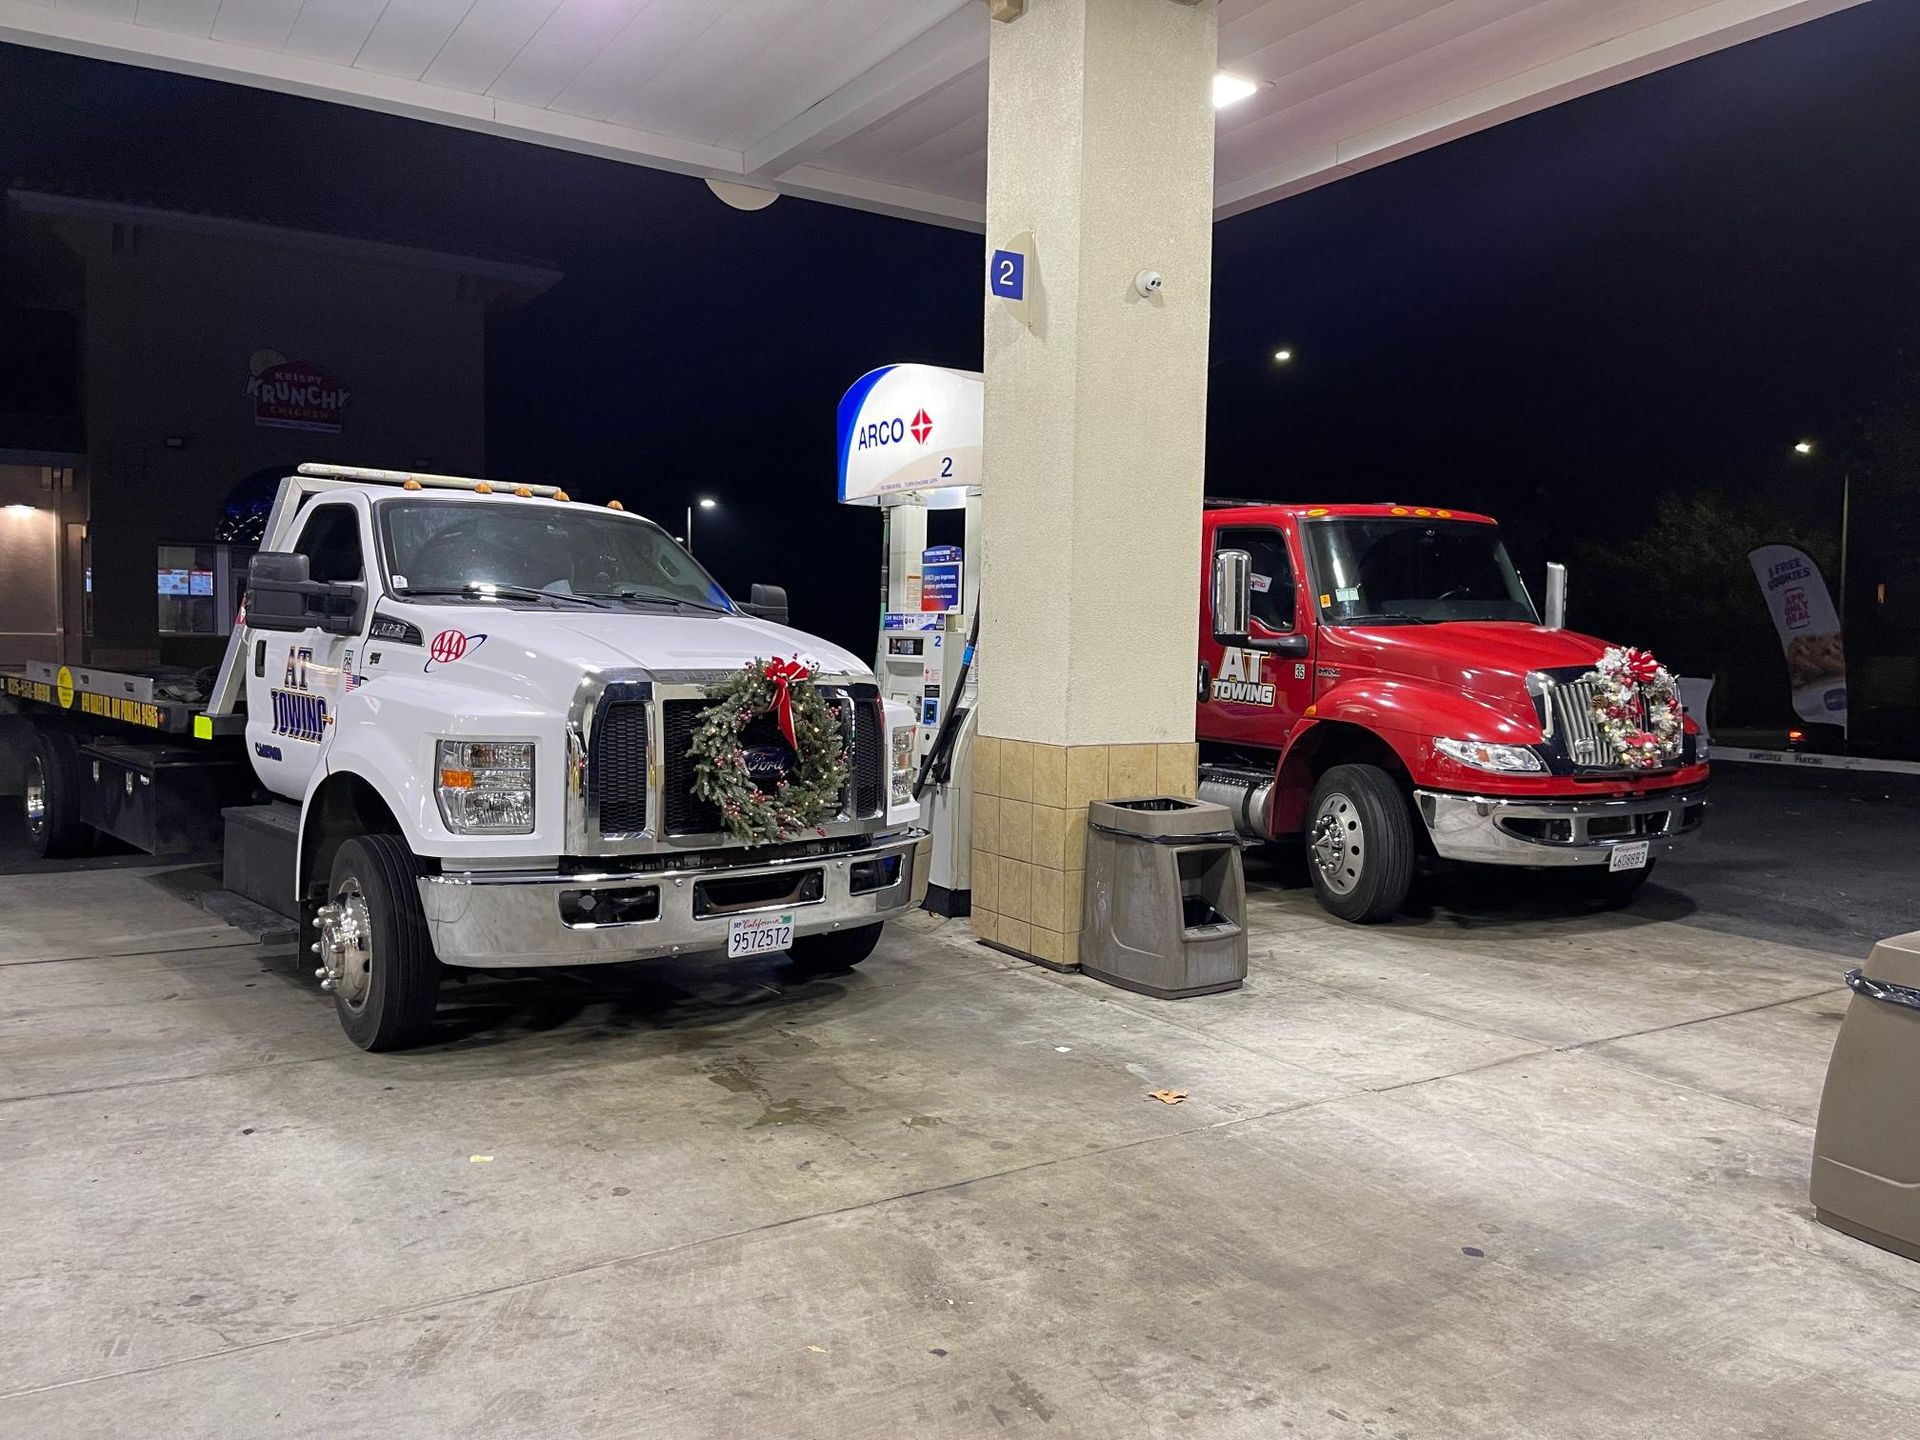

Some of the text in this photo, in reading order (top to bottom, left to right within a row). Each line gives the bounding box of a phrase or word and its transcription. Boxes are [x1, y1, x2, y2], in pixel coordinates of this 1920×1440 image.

[1000, 260, 1014, 286] 2
[245, 375, 351, 410] KRUNCHY
[858, 417, 904, 451] ARCO
[941, 456, 953, 478] 2
[1775, 558, 1802, 574] FREE
[431, 630, 466, 662] AAA
[934, 635, 942, 648] 2
[285, 645, 314, 691] AT
[1218, 646, 1270, 684] AT
[1296, 665, 1304, 679] 35
[1212, 681, 1275, 705] TOWING
[270, 687, 328, 745] TOWING
[748, 753, 785, 772] Ford
[743, 918, 779, 930] California
[733, 926, 790, 952] 95725T2
